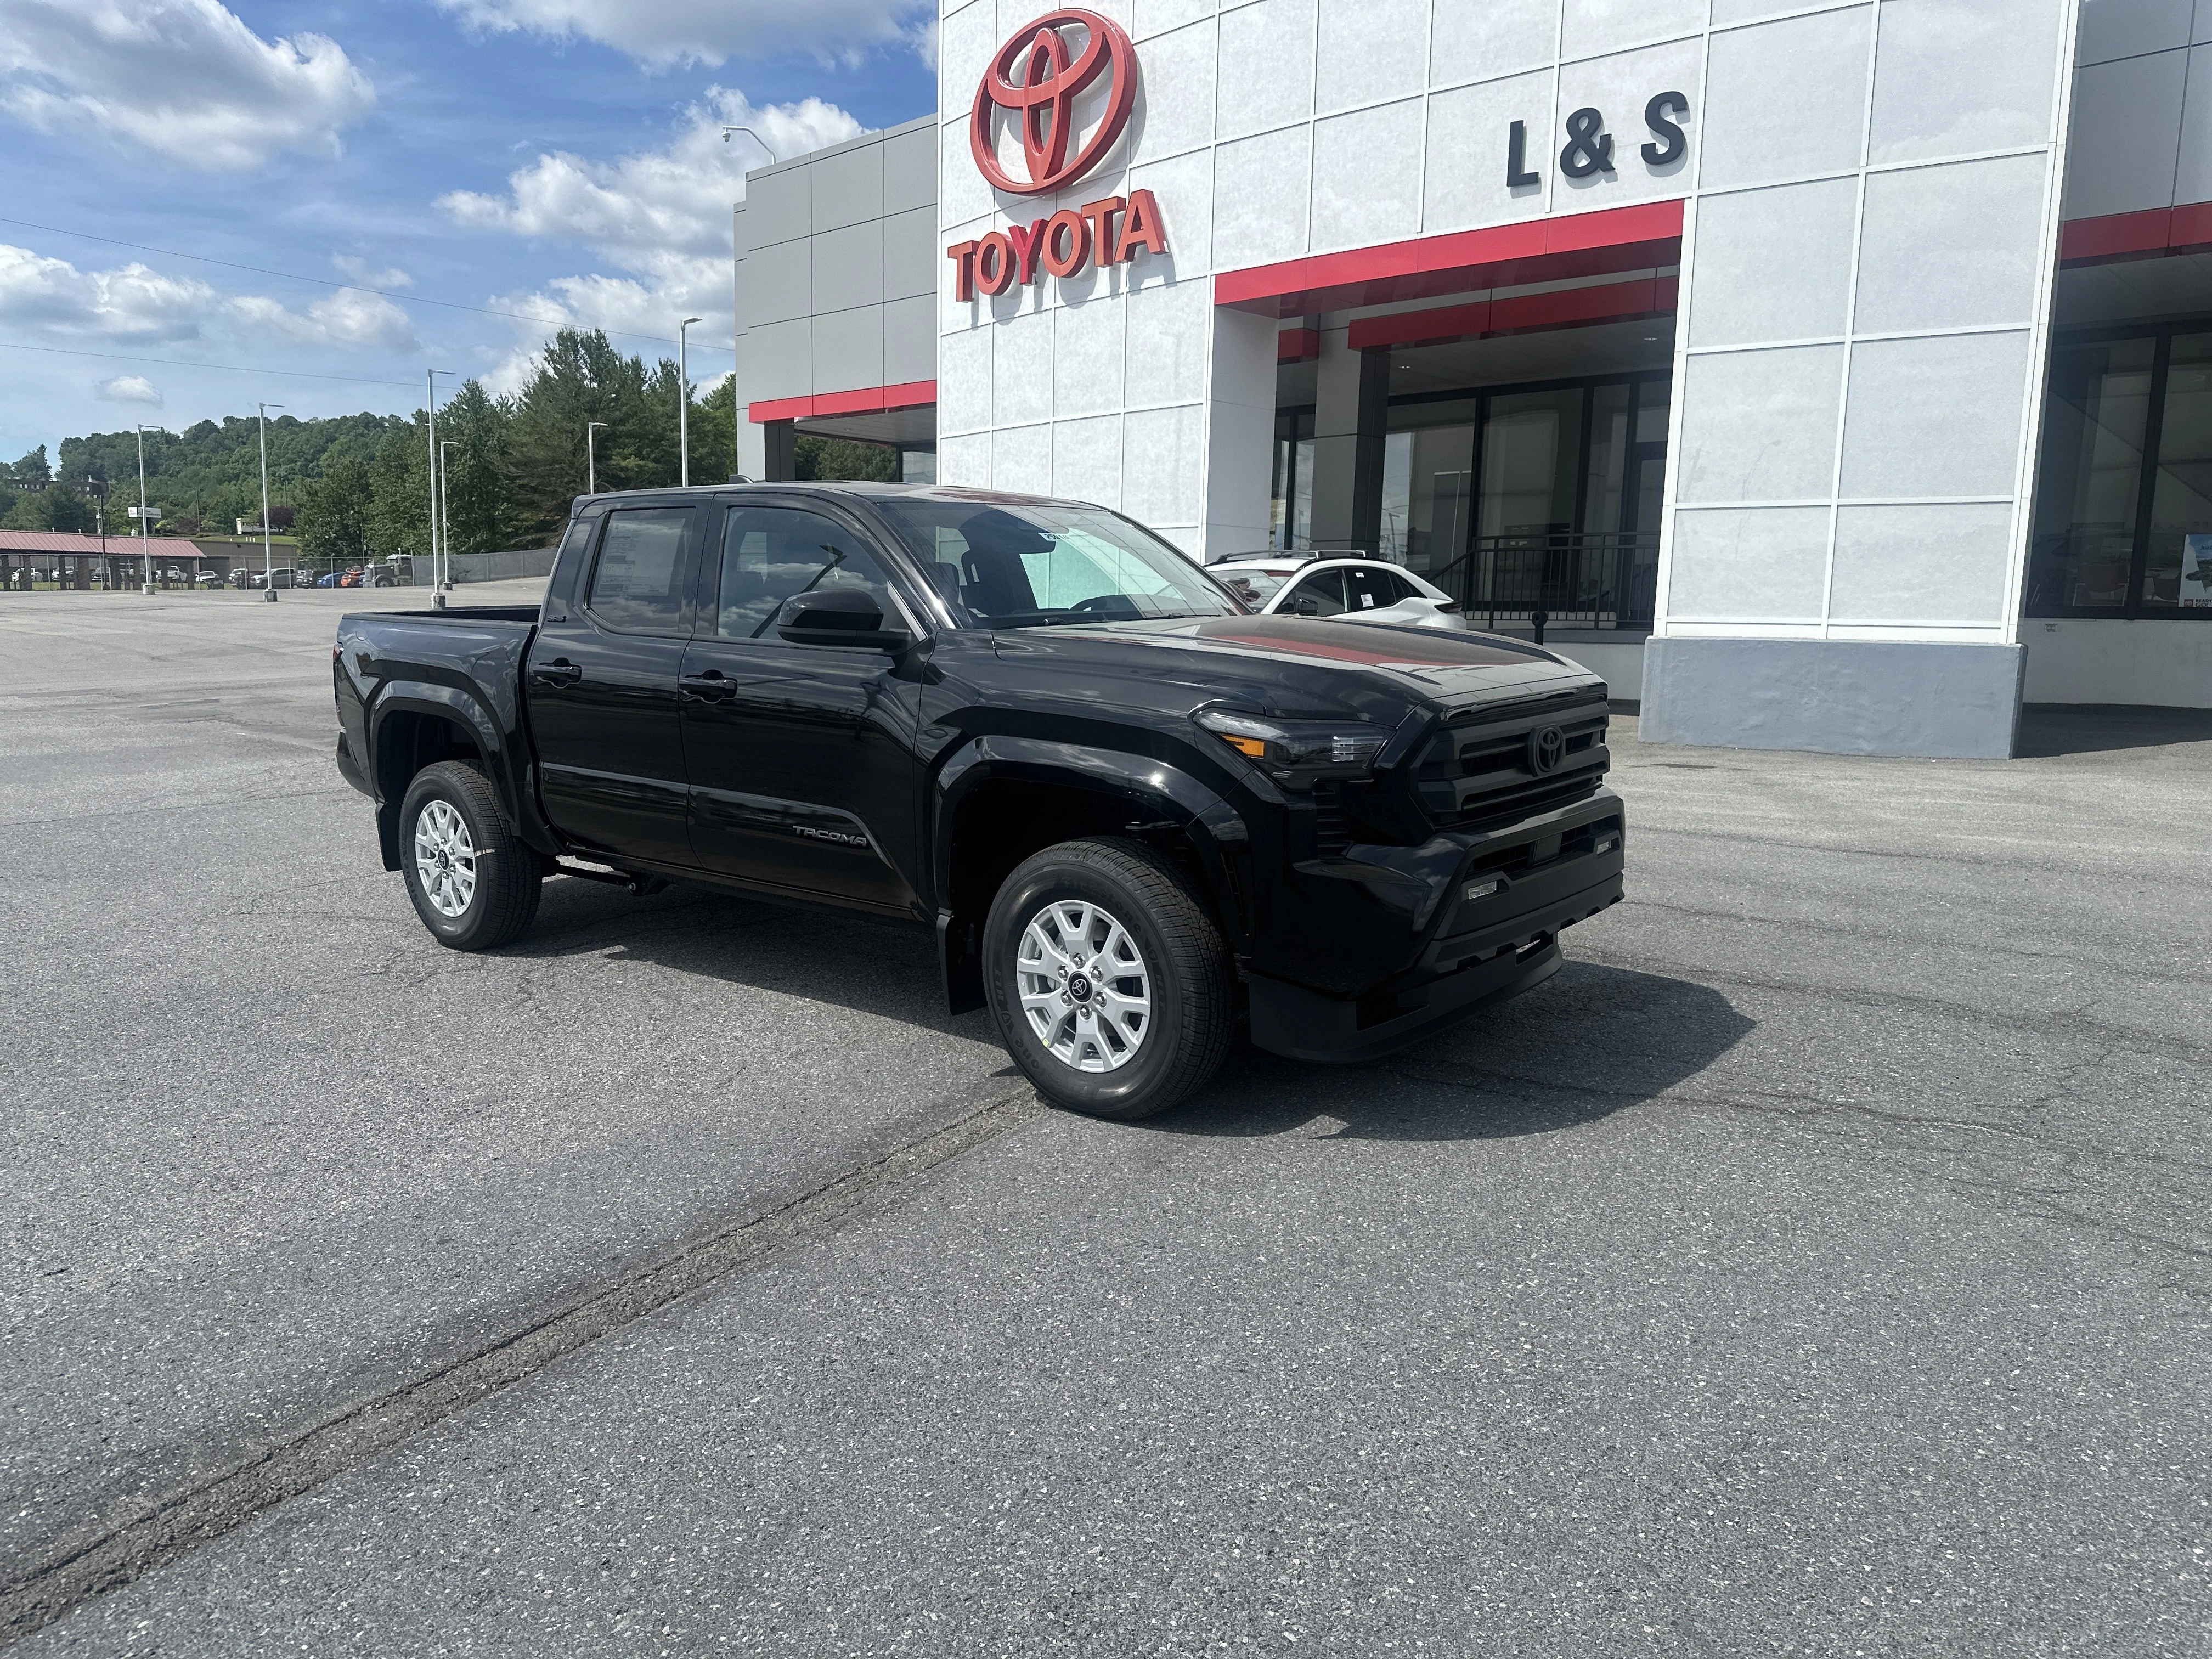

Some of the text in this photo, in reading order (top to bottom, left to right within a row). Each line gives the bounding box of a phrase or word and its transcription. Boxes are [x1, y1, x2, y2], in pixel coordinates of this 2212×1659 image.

[1506, 91, 1688, 187] L & S
[947, 189, 1169, 302] TOYOTA
[793, 825, 867, 846] TACOMA
